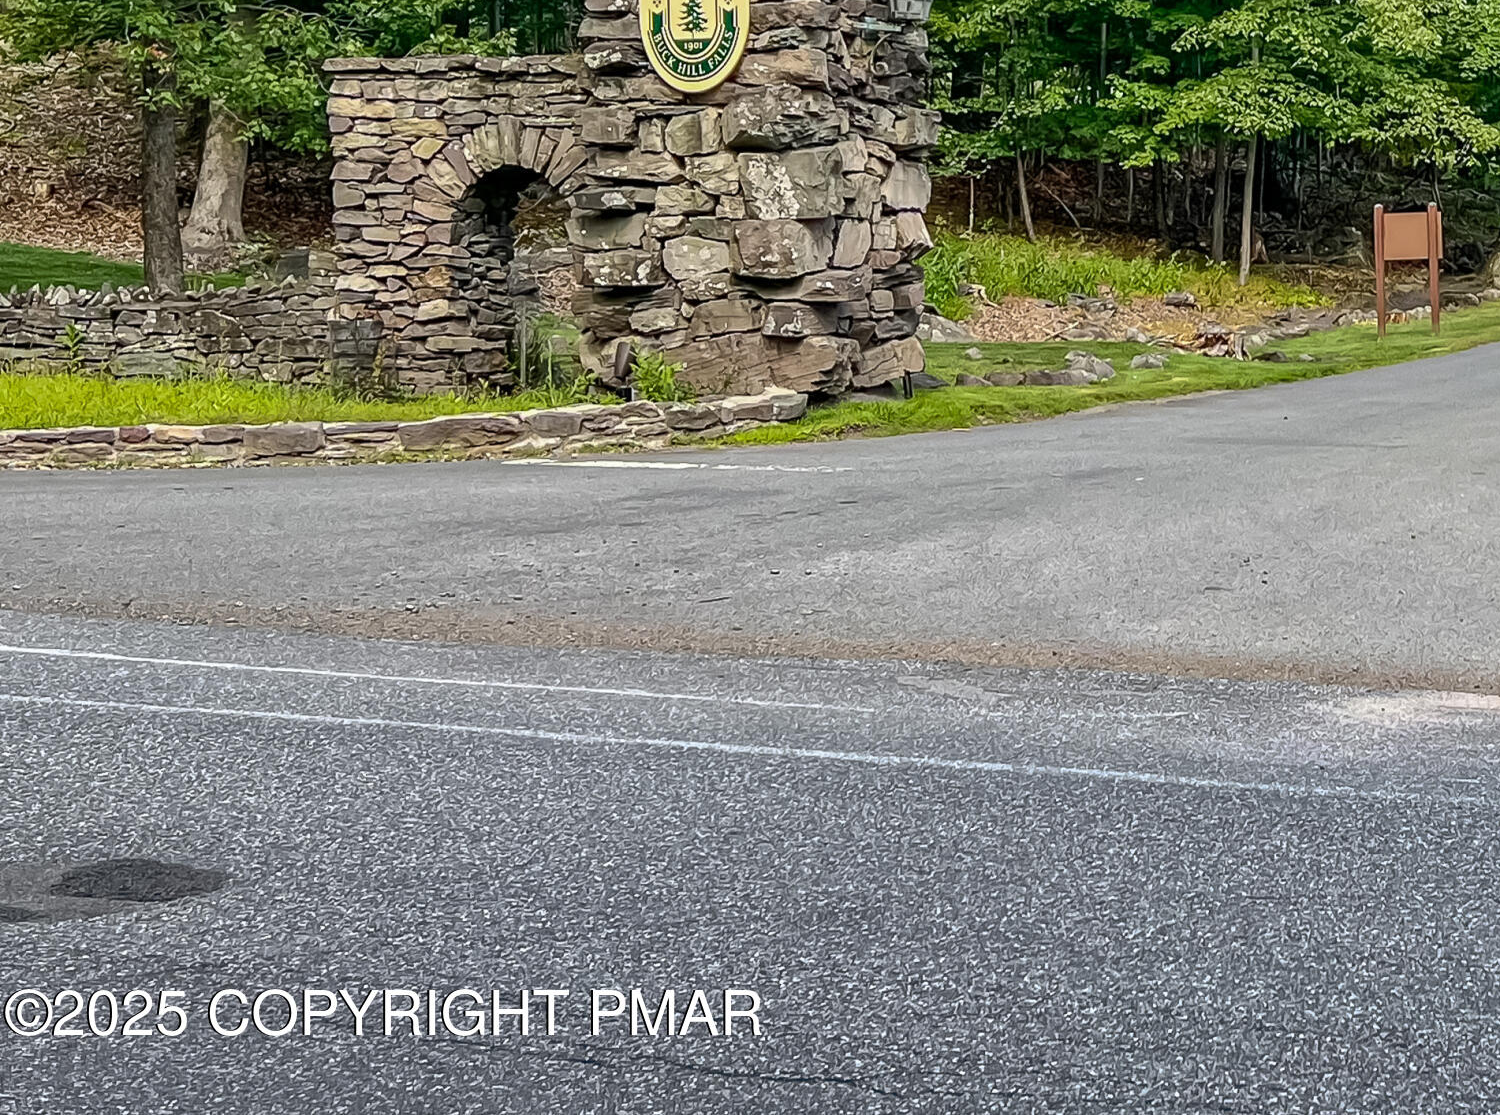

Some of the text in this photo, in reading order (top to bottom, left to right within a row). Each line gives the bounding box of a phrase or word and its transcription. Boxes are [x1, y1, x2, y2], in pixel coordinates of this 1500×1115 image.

[653, 30, 734, 76] BUCK HILL FALLS
[683, 41, 704, 52] 1901
